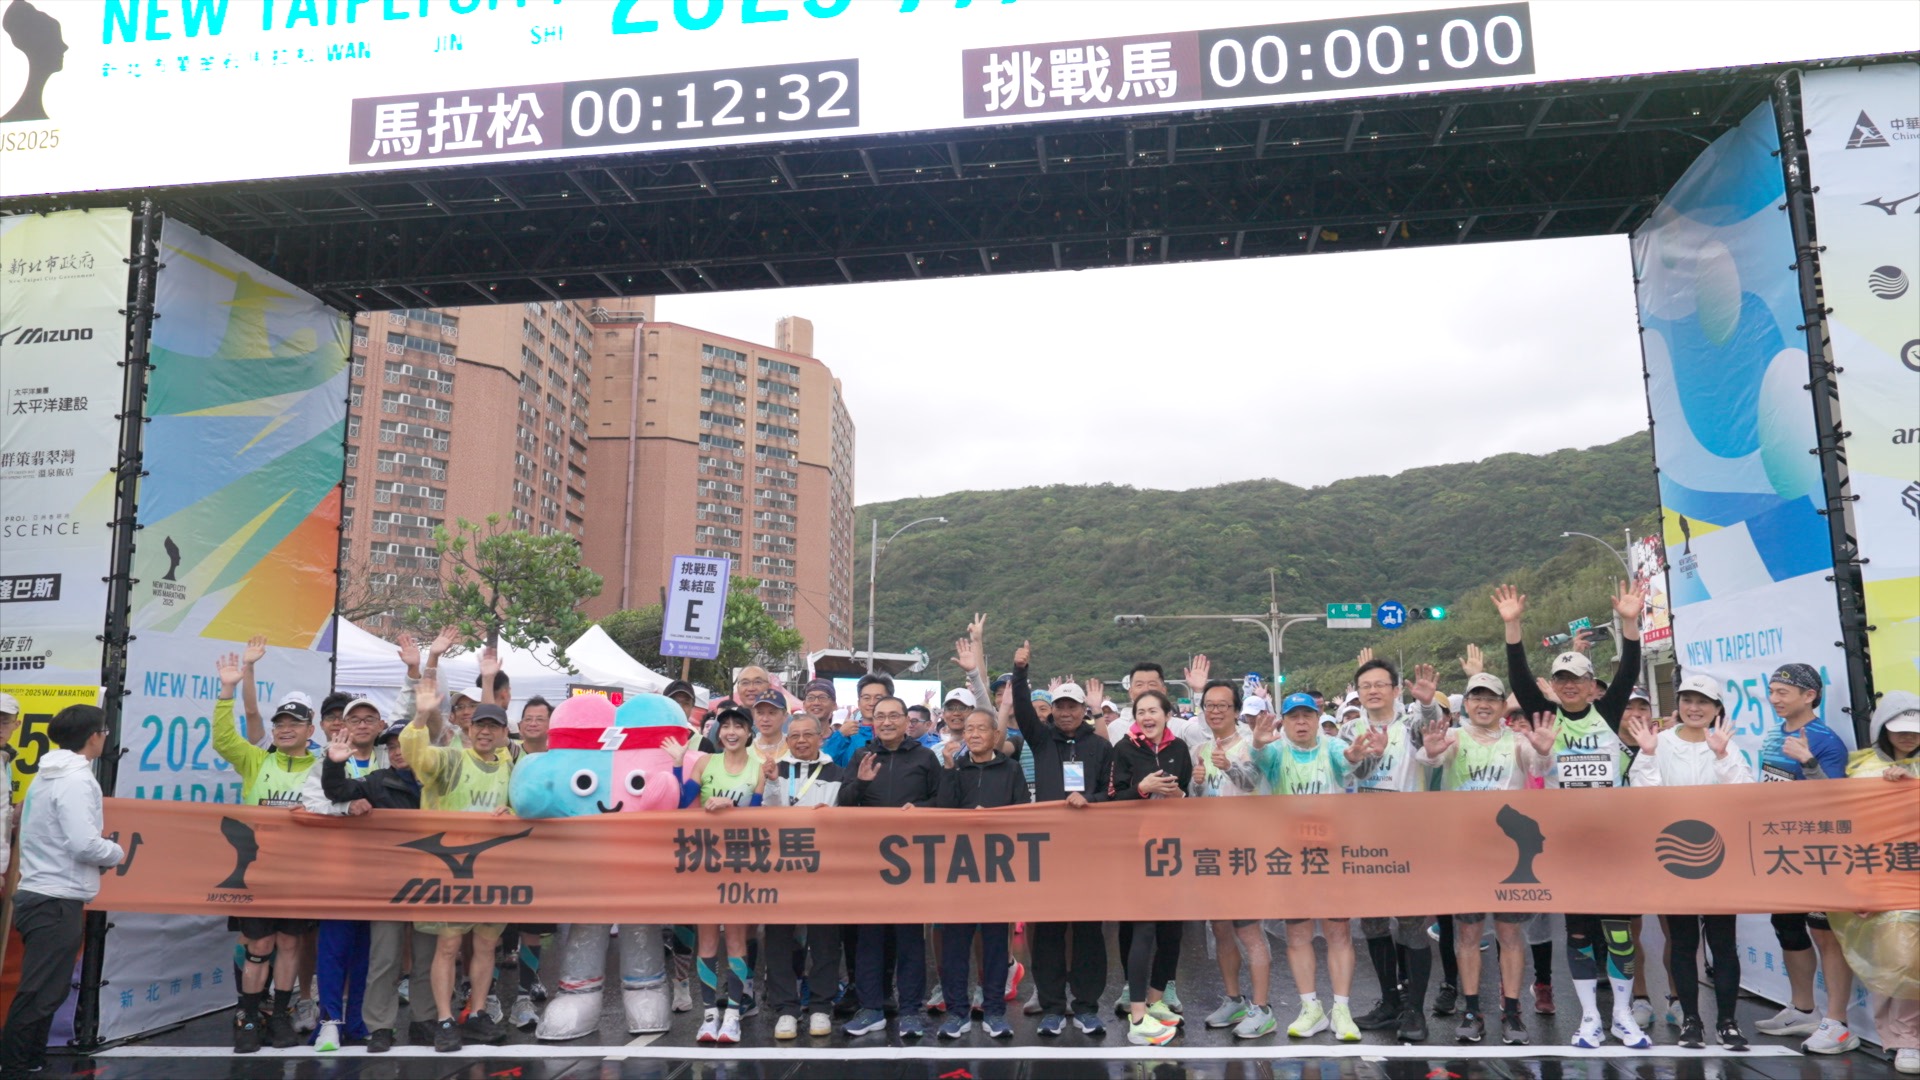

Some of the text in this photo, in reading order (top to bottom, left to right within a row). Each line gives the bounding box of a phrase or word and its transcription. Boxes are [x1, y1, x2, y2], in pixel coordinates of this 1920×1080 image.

[103, 0, 229, 44] NEW
[327, 41, 371, 61] WAN
[1209, 14, 1523, 88] 00:00:00
[982, 41, 1178, 111] 挑戰馬
[570, 71, 851, 137] 00:12:32
[367, 92, 545, 158] 馬拉松
[8, 252, 95, 276] 新北市政府
[12, 397, 88, 415] 太平洋建設
[681, 561, 718, 577] 挑戰馬
[679, 579, 716, 594] 集結區
[684, 599, 703, 632] E
[1686, 627, 1783, 666] NEW TAIPEI CITY
[25, 689, 41, 697] 2025
[58, 689, 95, 697] MARATHON
[144, 671, 187, 698] NEW
[1563, 764, 1607, 777] 21129
[1762, 819, 1852, 835] 太平洋集團
[673, 828, 821, 874] 挑戰馬
[879, 832, 1051, 885] START
[1192, 846, 1330, 876] 富邦金控
[1341, 845, 1389, 858] Fubon
[1342, 861, 1411, 875] Financial
[716, 881, 779, 905] 10km
[1494, 888, 1553, 902] WJS2025
